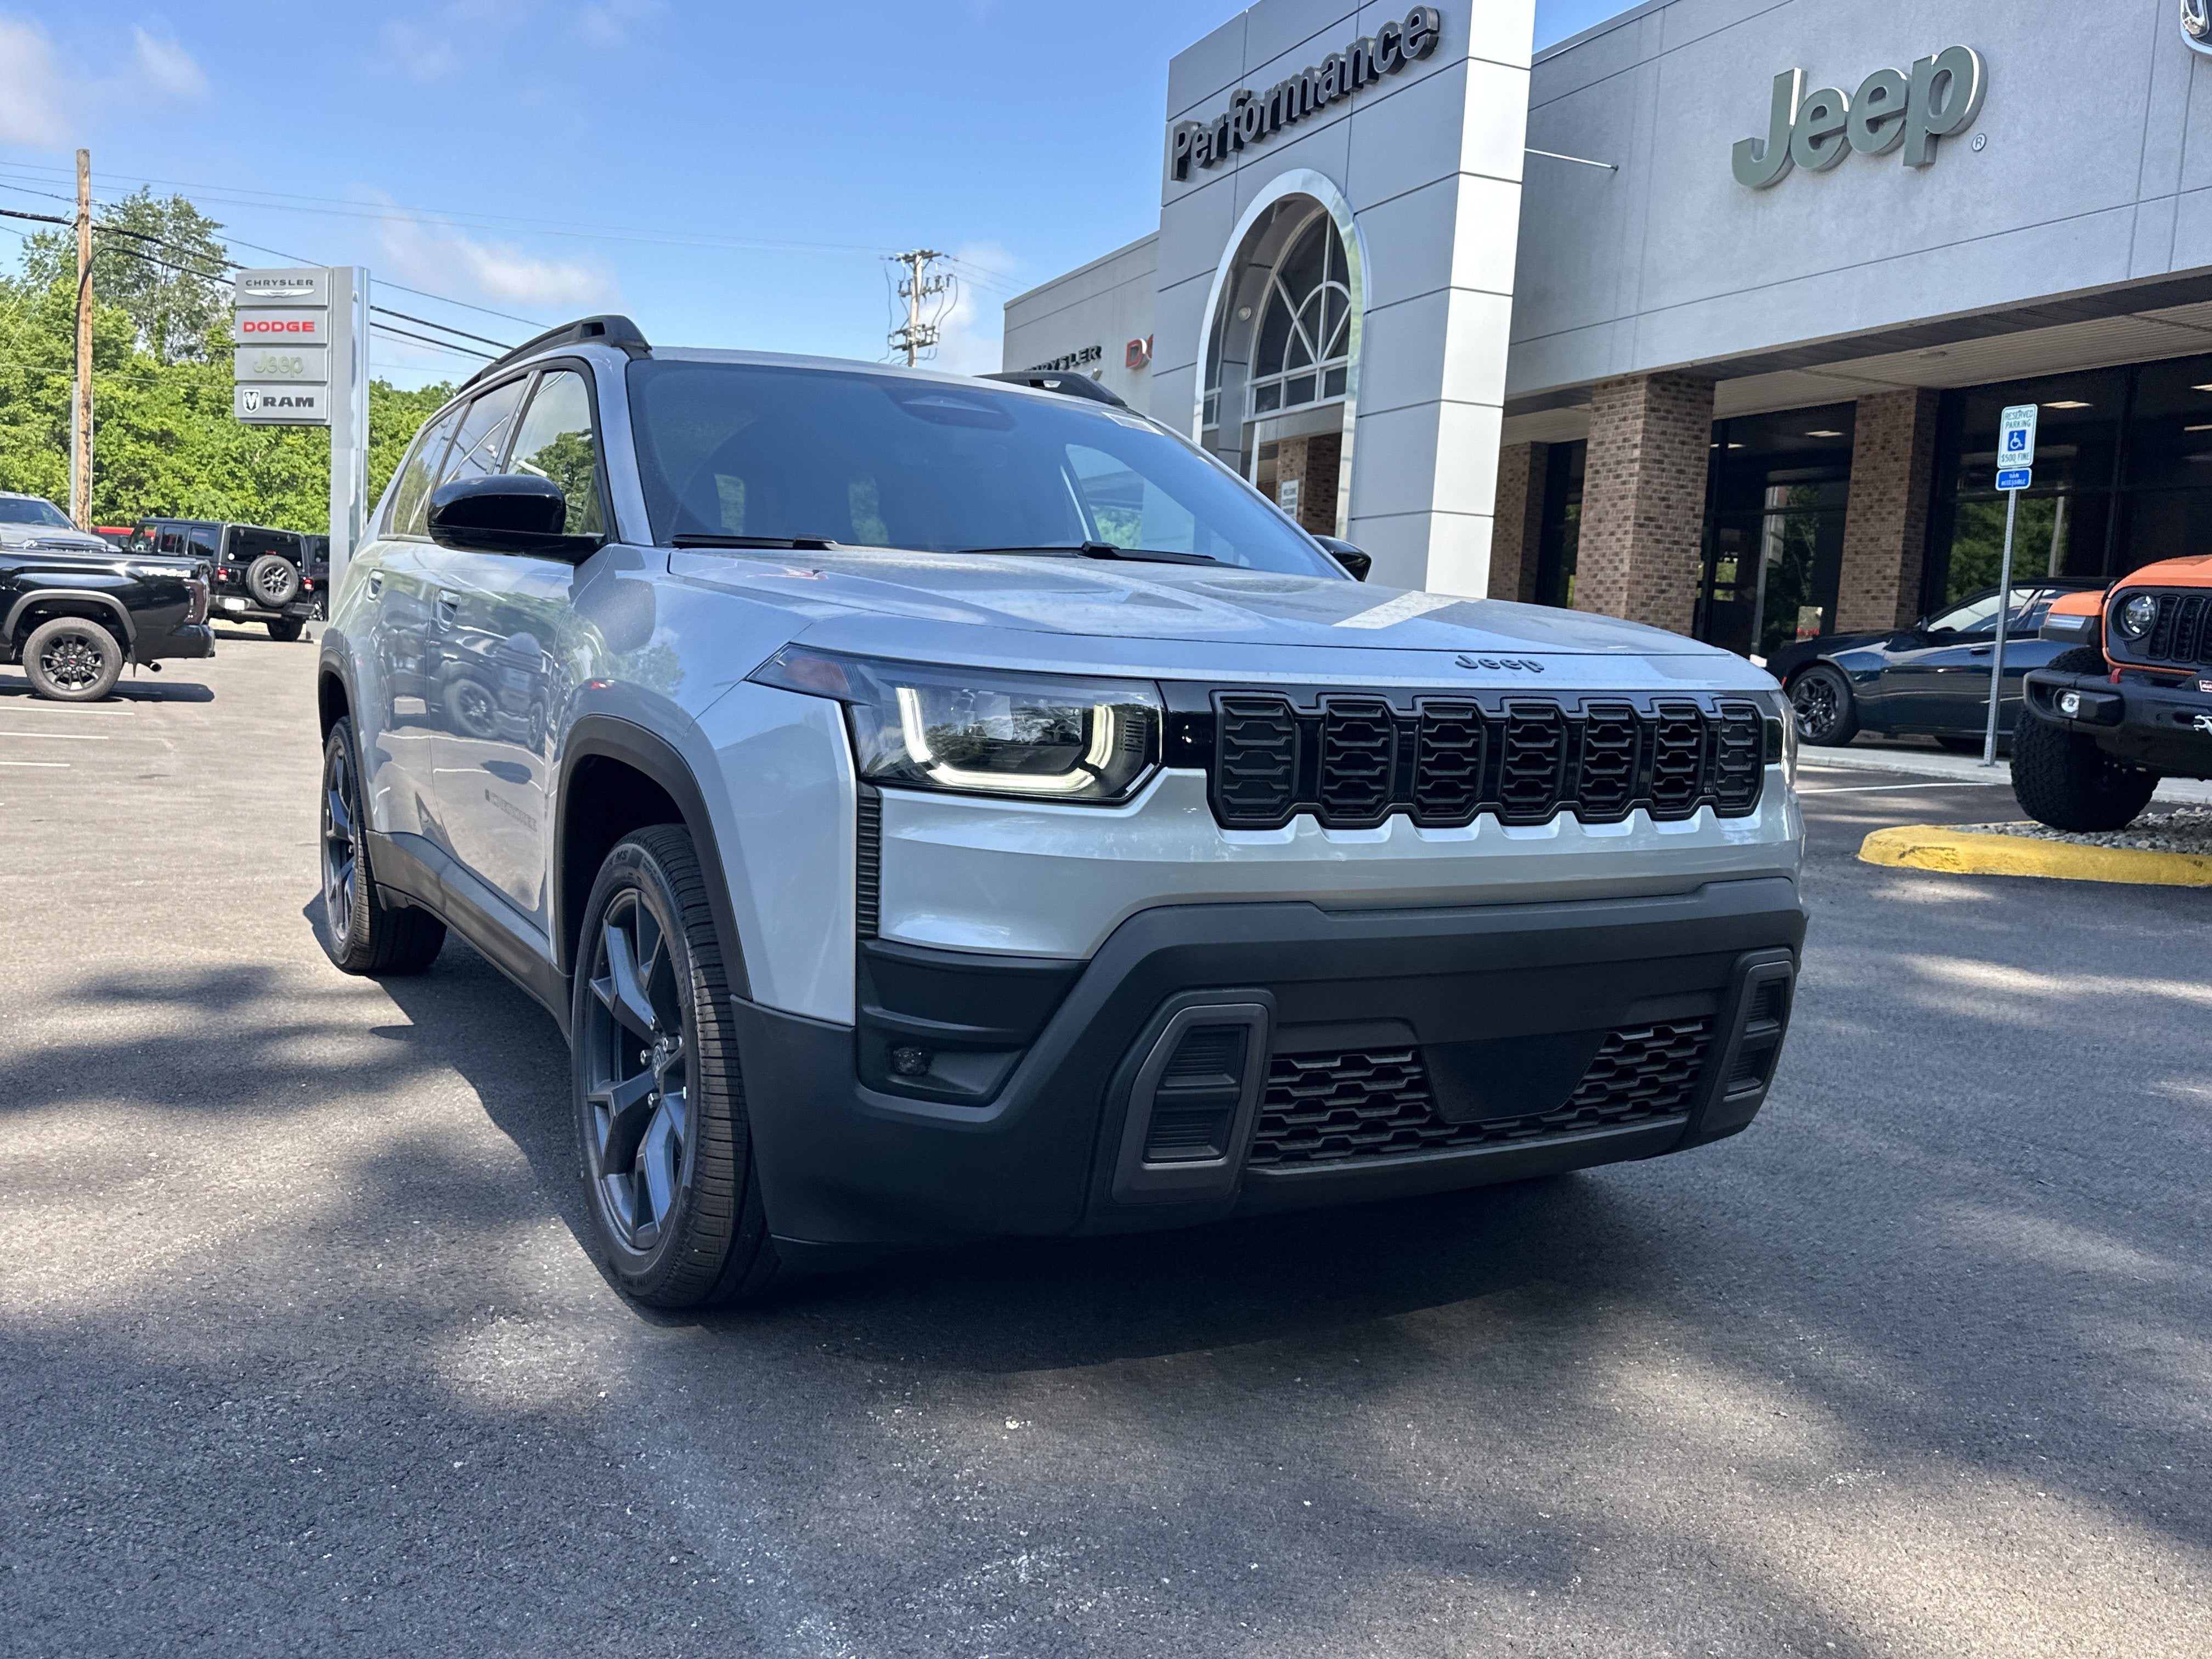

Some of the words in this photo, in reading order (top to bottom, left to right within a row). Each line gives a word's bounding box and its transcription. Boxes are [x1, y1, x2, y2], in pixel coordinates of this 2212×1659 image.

[1171, 4, 1440, 181] Performance
[1732, 44, 1989, 189] Jeep
[243, 321, 315, 332] DODGE
[253, 351, 303, 378] Jeep
[263, 397, 314, 408] RAM
[2005, 419, 2031, 429] PARKING
[1455, 655, 1544, 673] Jeep
